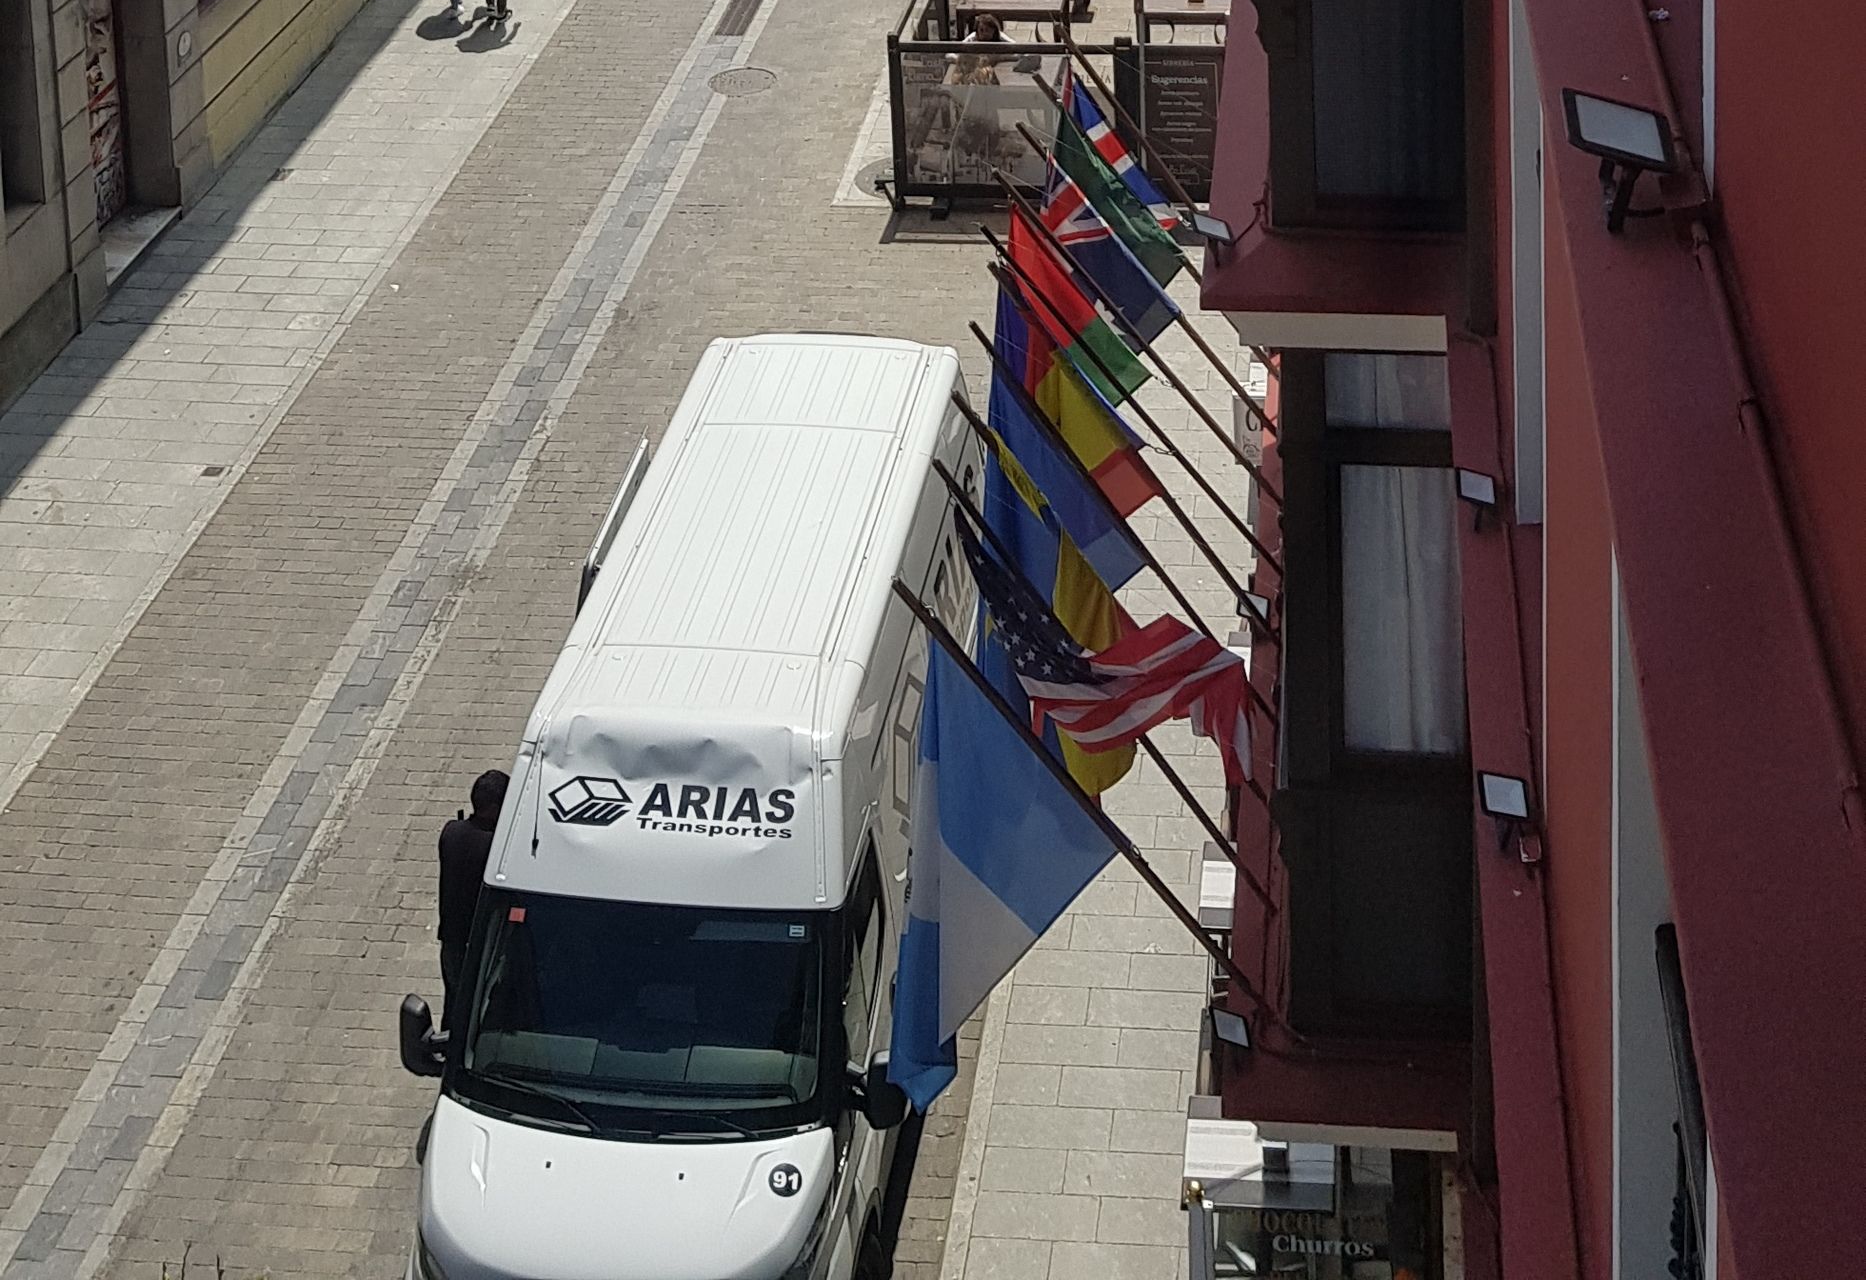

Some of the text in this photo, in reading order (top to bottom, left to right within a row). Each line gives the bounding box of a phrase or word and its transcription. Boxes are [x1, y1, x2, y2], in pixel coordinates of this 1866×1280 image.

[1151, 74, 1208, 86] Sugerencias
[638, 782, 796, 824] ARIAS
[636, 816, 793, 839] Transportes
[772, 1170, 800, 1191] 91
[1271, 1234, 1376, 1257] Churros
